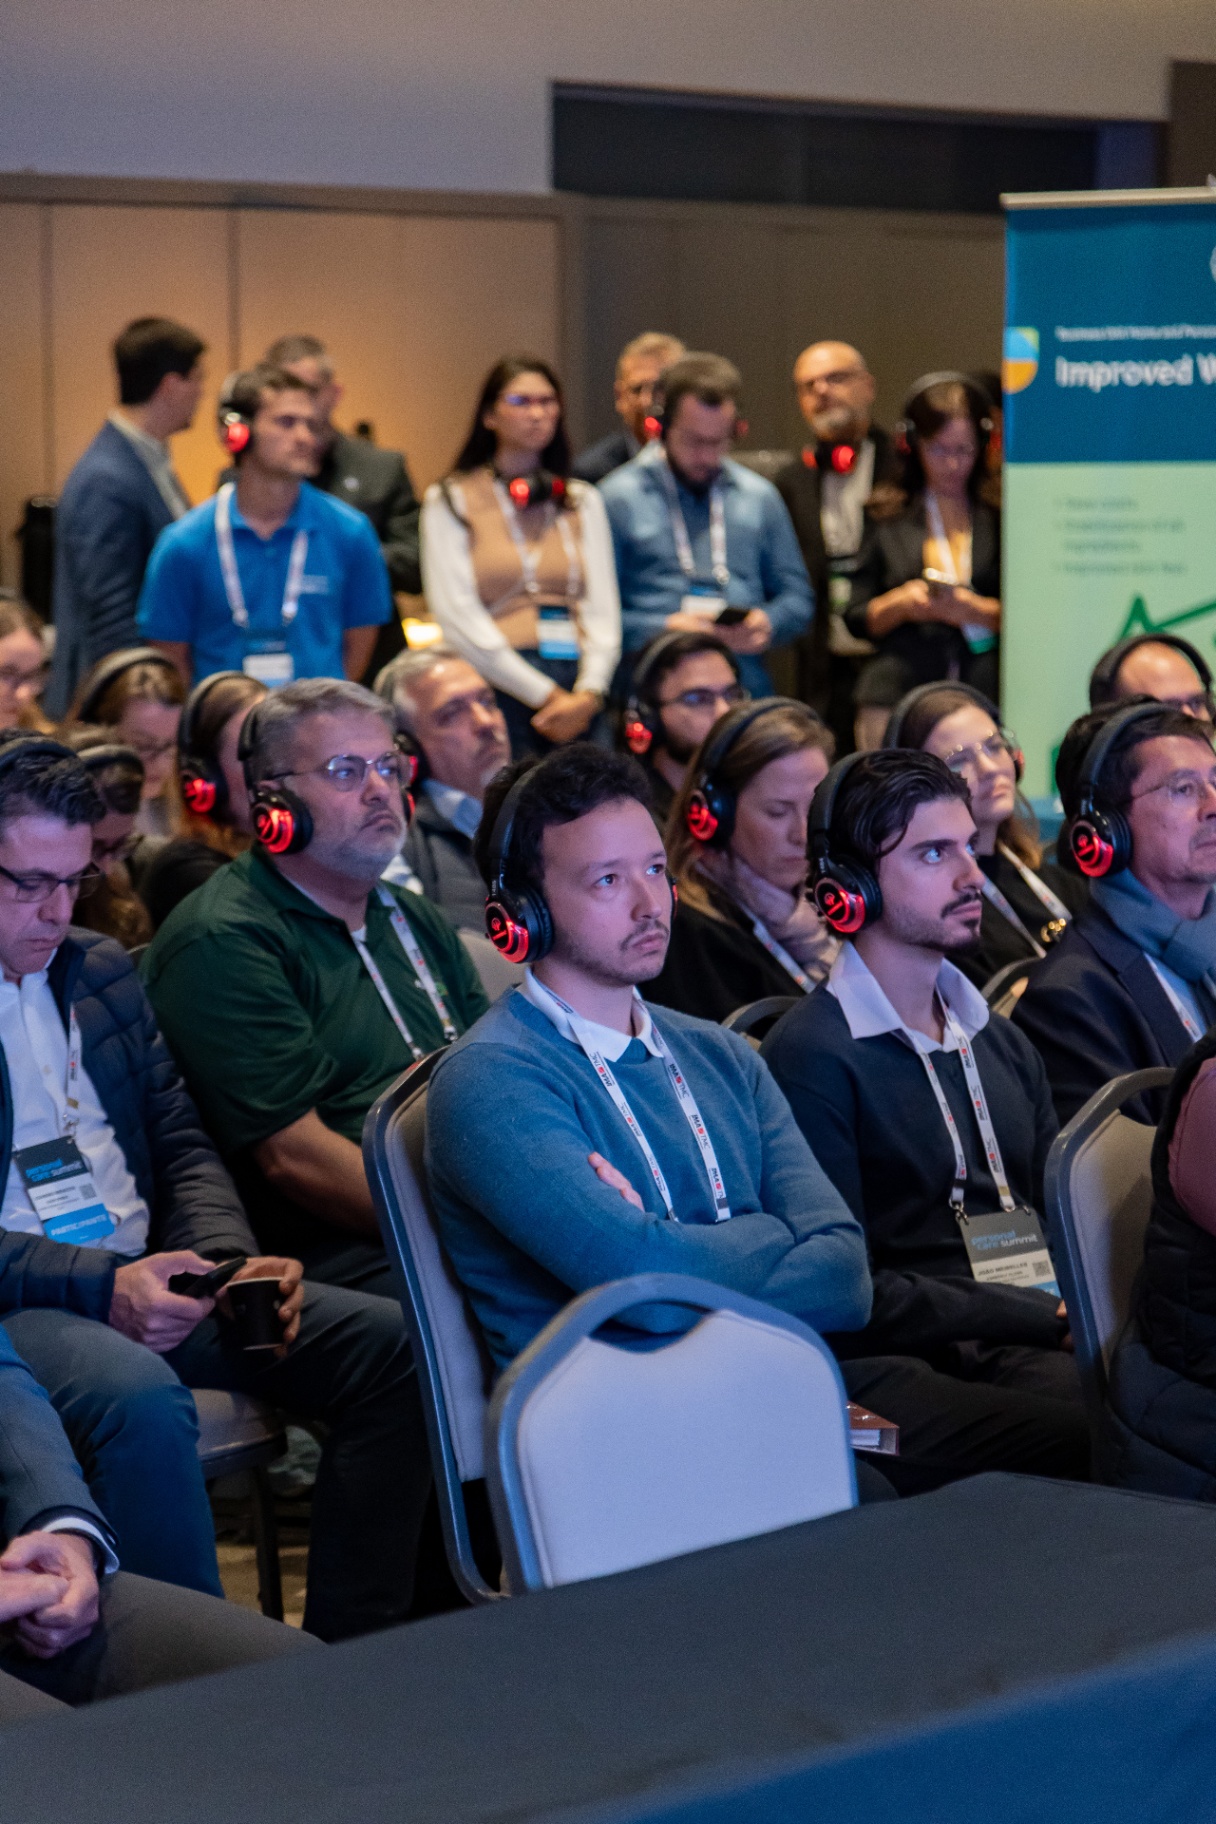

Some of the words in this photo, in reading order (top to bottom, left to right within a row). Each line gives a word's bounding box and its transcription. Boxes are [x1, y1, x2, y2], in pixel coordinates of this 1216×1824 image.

[1055, 353, 1194, 393] Improved
[691, 1114, 702, 1128] IMA
[711, 1168, 720, 1182] IMA
[1000, 1233, 1038, 1248] summit
